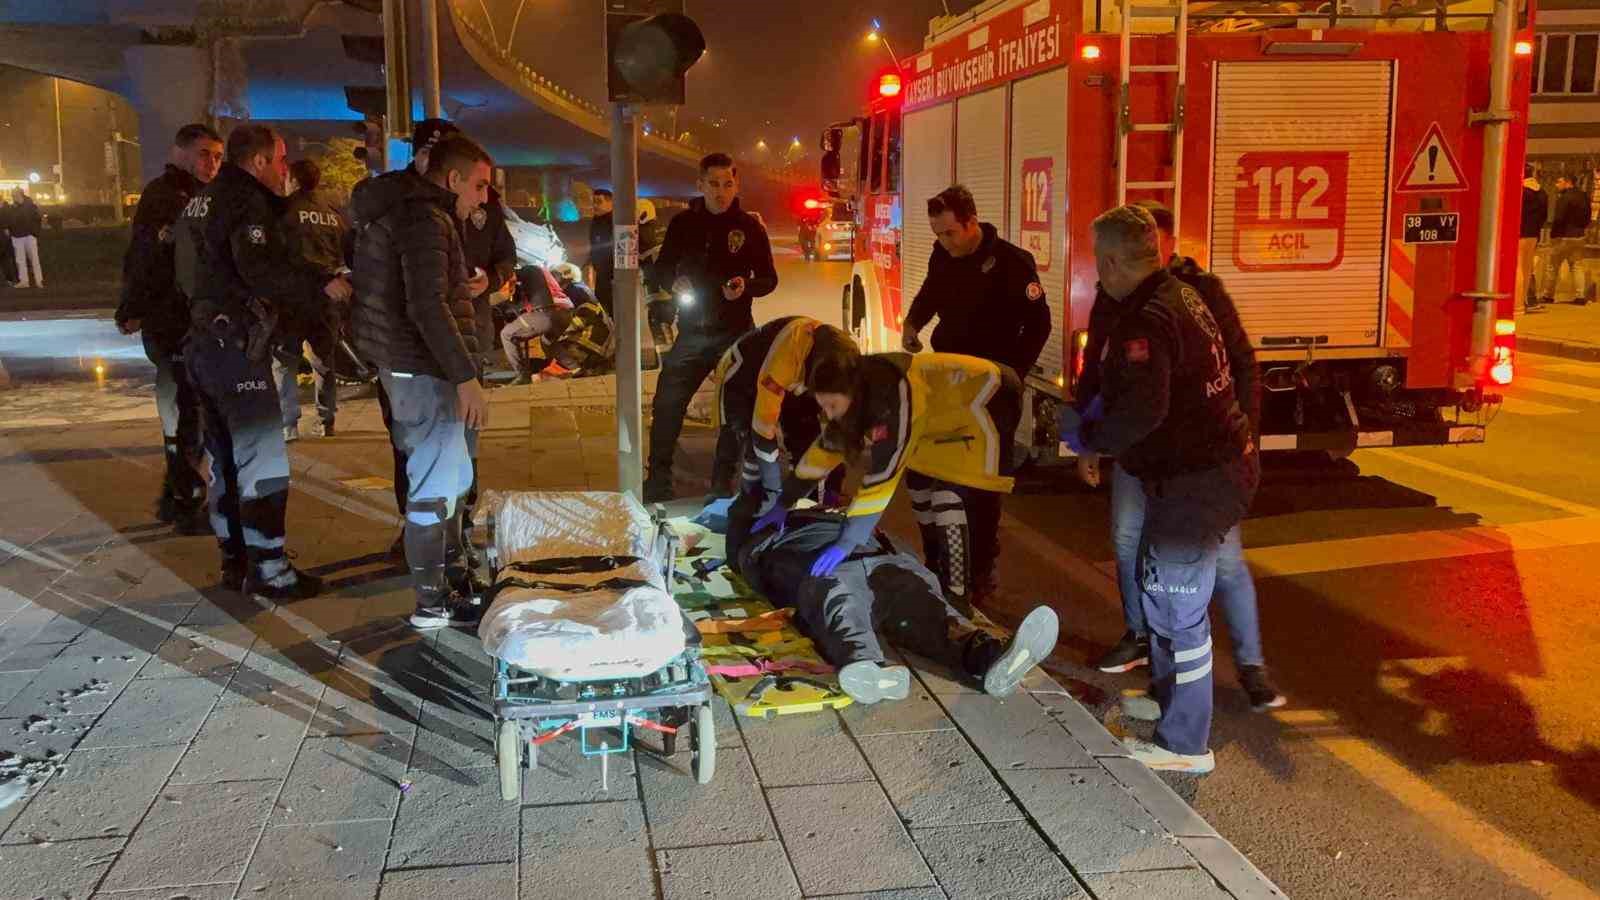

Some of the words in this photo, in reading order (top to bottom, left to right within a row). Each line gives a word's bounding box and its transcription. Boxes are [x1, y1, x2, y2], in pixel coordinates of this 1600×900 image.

[936, 47, 995, 97] BÜYÜKŞEHİR
[998, 14, 1060, 77] İTFAİYESİ
[1025, 171, 1048, 222] 112
[1252, 165, 1330, 220] 112
[1407, 216, 1422, 228] 38
[1440, 215, 1455, 227] VY
[1419, 230, 1438, 240] 108
